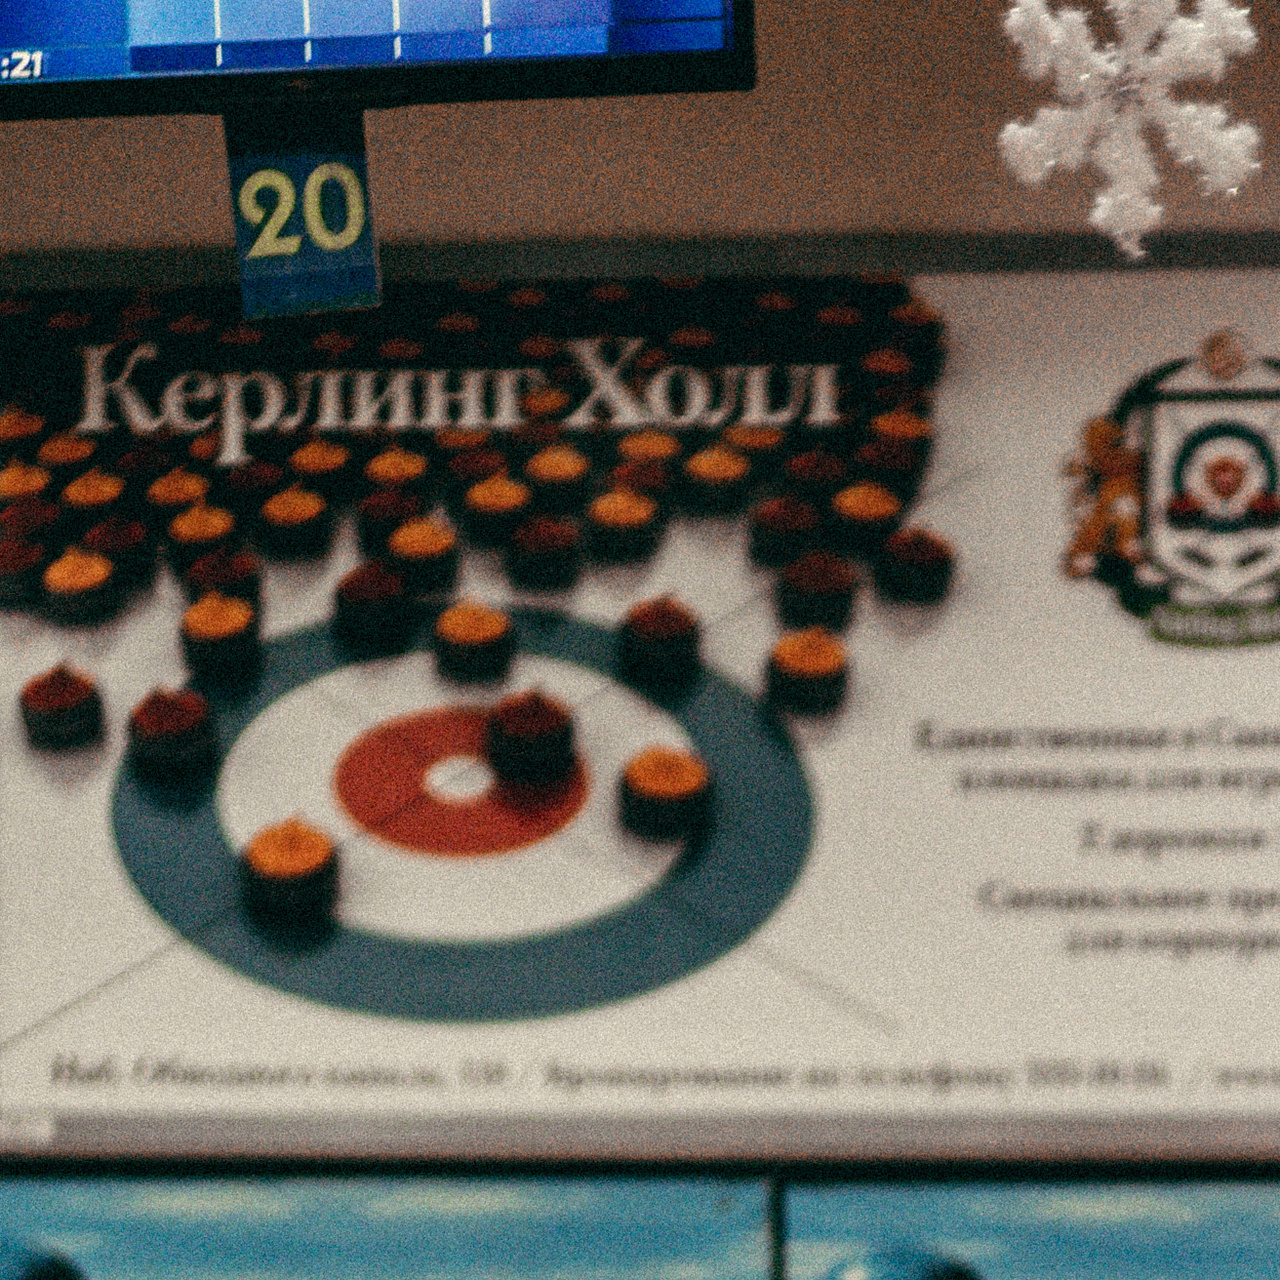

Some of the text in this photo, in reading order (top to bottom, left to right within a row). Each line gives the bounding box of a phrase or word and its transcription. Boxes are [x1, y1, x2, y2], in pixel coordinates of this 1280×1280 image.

[238, 161, 366, 260] 20
[75, 336, 842, 468] Керлинг Холл
